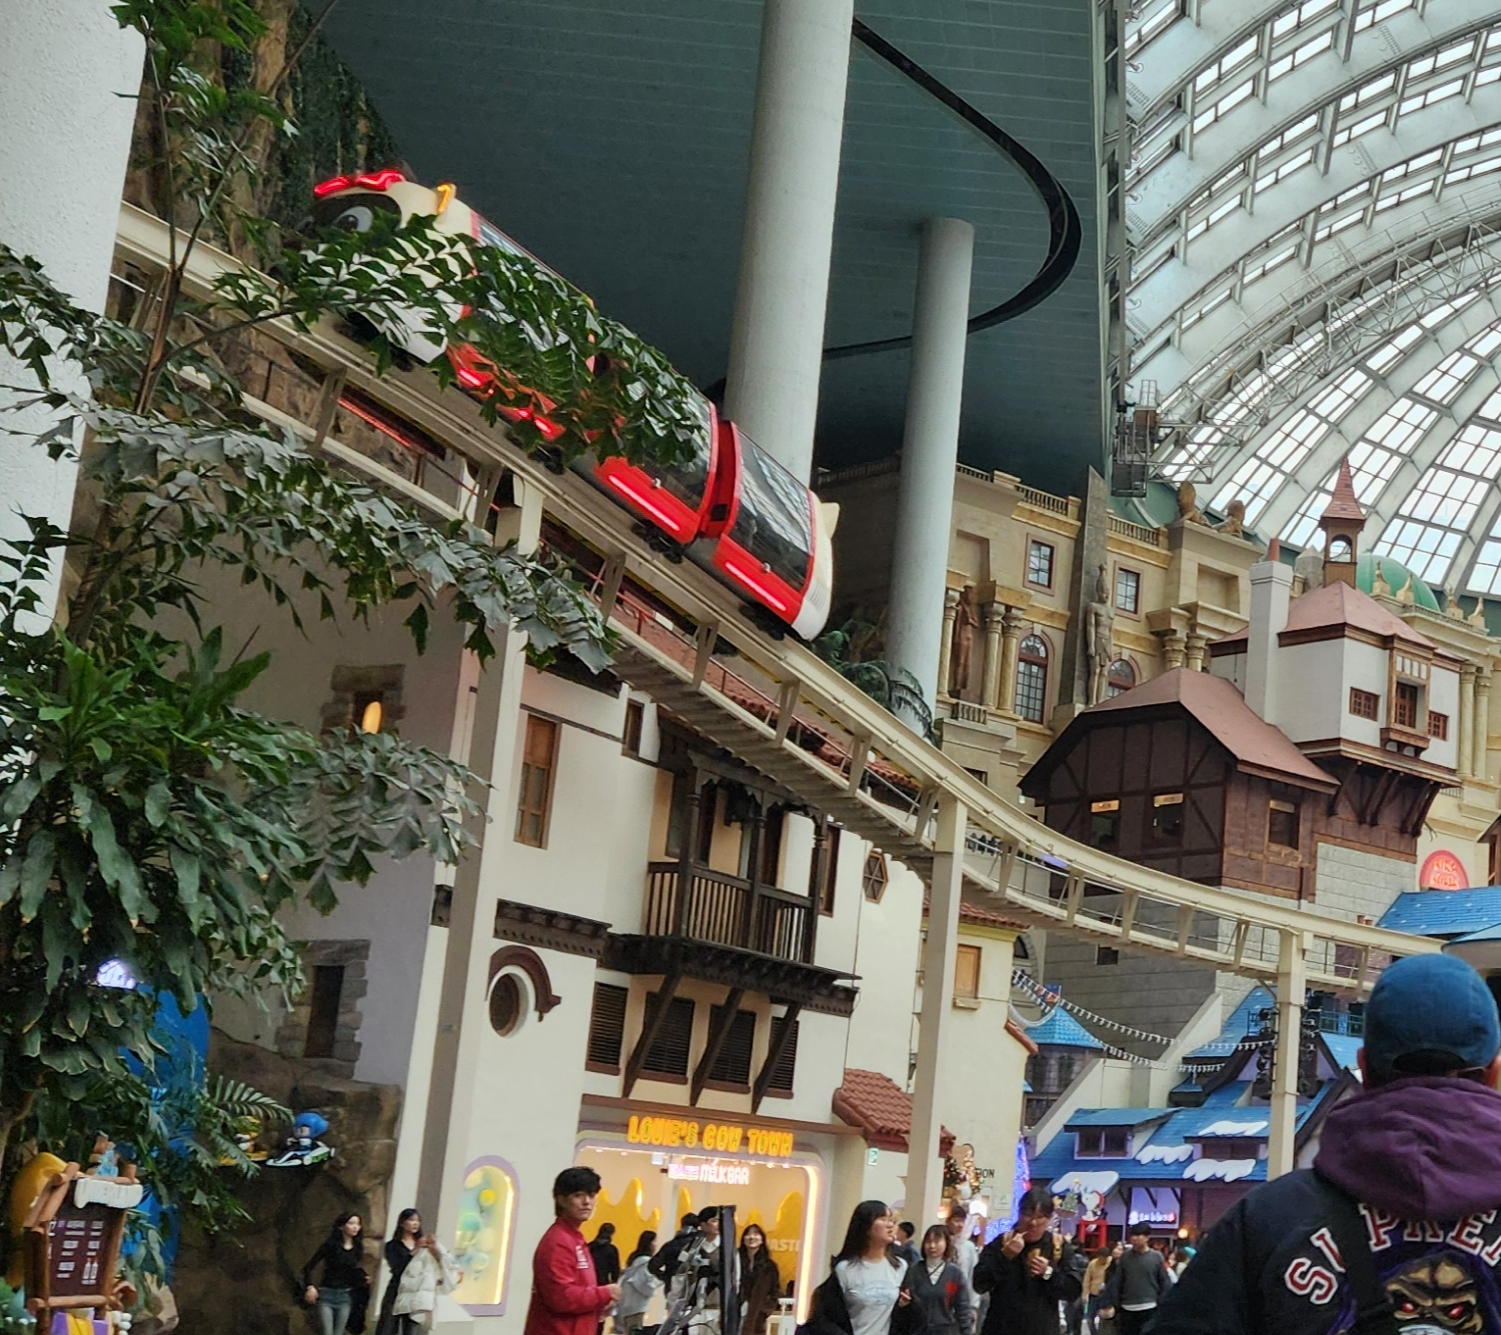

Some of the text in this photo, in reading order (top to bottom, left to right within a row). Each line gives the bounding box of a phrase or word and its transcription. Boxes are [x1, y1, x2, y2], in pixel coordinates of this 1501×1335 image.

[627, 1115, 794, 1158] LOUIE'S COW TOWN
